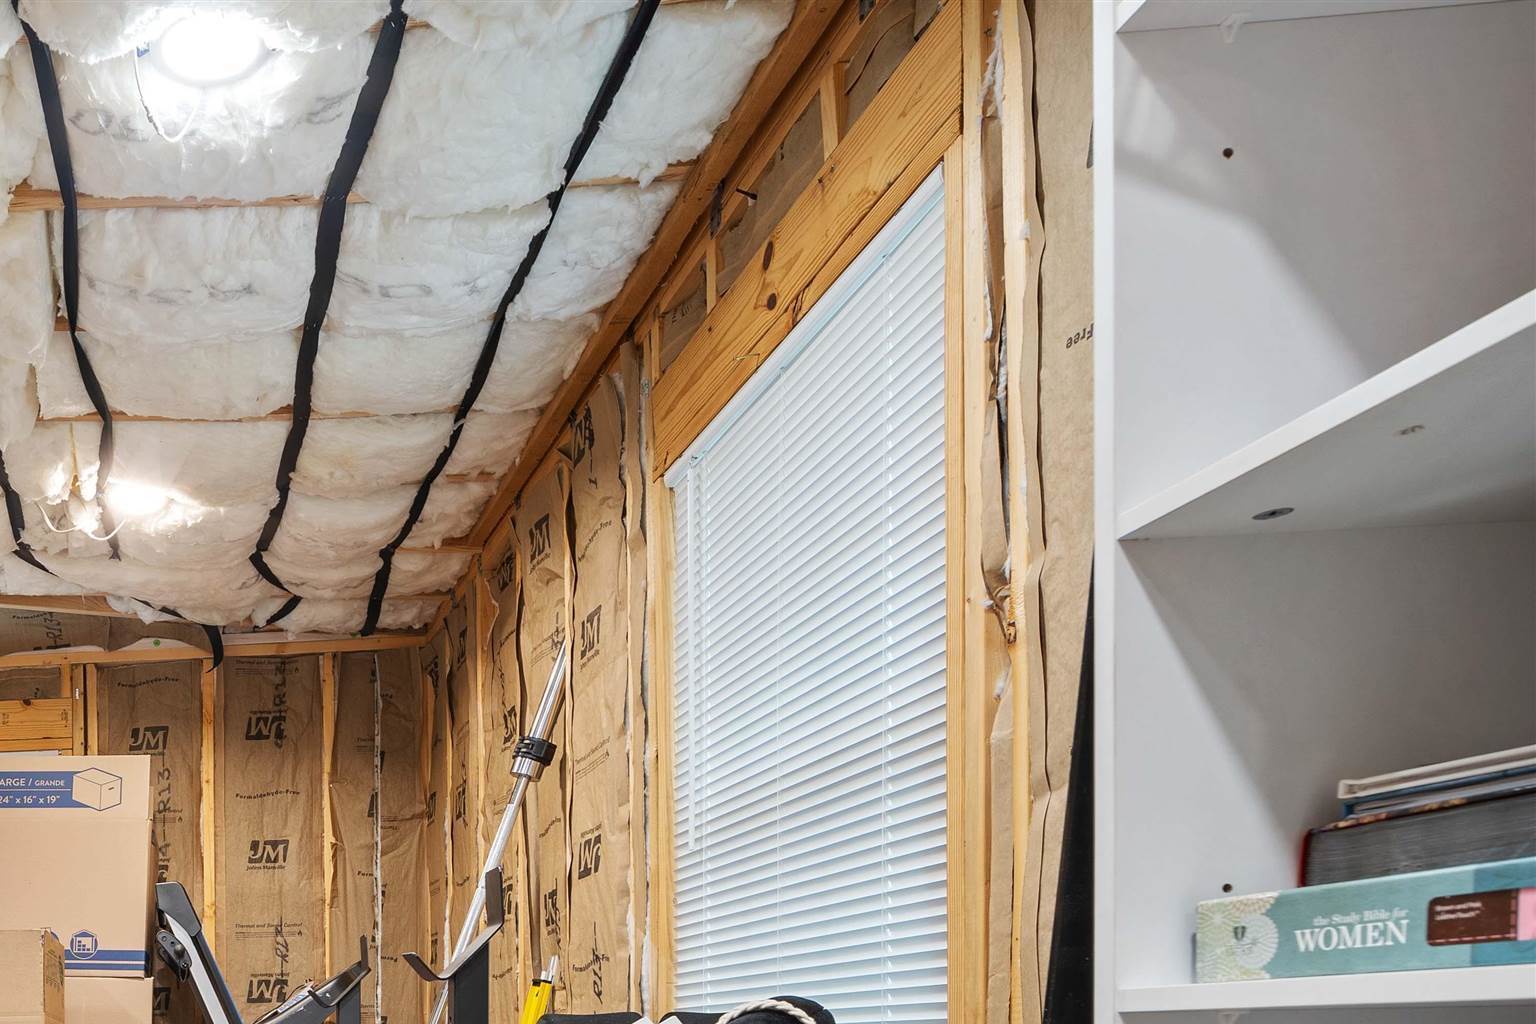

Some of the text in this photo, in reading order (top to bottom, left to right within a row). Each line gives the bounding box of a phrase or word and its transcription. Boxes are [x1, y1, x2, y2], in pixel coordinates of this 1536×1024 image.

[23, 795, 37, 804] 16"
[46, 795, 61, 804] 19"
[248, 839, 290, 863] JM
[1314, 908, 1409, 926] the Study Bible for
[1293, 919, 1410, 953] WOMEN
